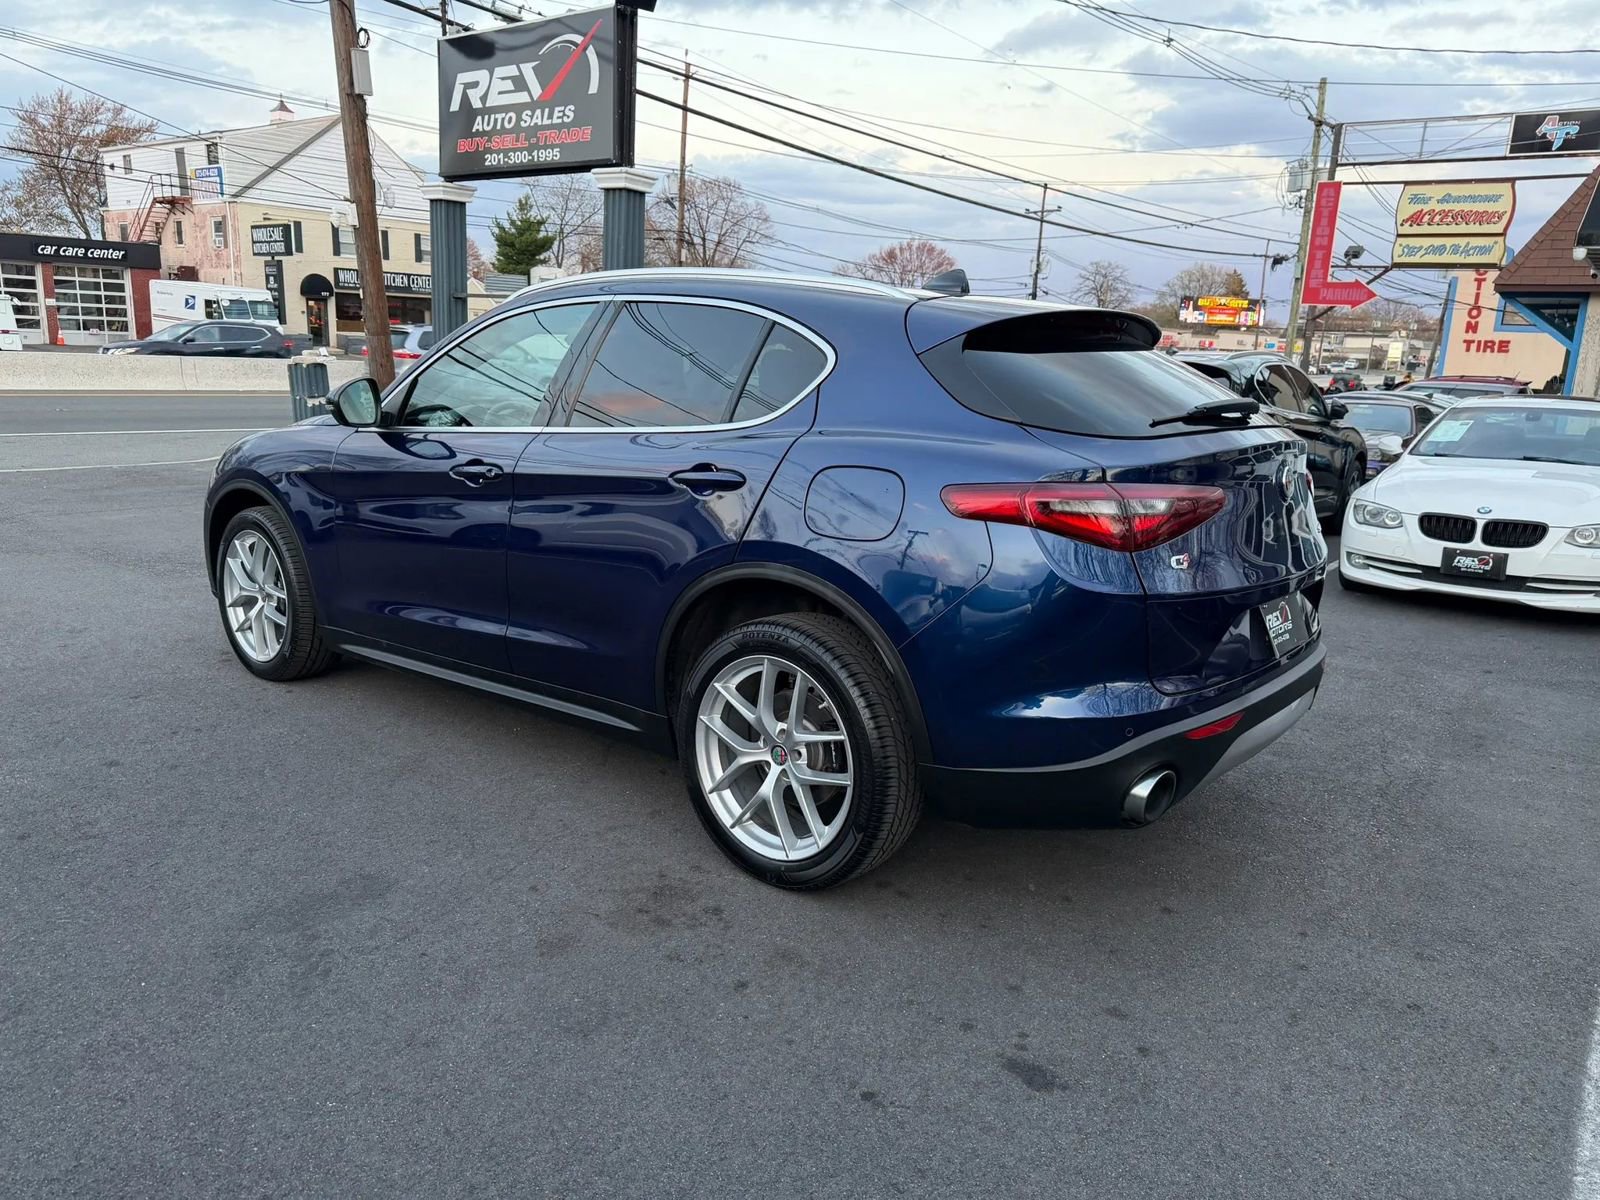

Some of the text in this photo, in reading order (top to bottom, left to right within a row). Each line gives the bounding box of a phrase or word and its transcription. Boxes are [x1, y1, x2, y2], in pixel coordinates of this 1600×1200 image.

[472, 104, 575, 132] AUTO SALES
[484, 148, 560, 166] 201-300-1995
[1400, 208, 1507, 227] ACCESSORIES
[252, 227, 284, 242] WHOLESALE
[37, 244, 125, 260] car care center
[253, 242, 286, 253] KITCHEN CENTER
[383, 273, 408, 287] ITCHEN
[1320, 288, 1368, 301] PARKING
[1463, 339, 1511, 353] TIRE
